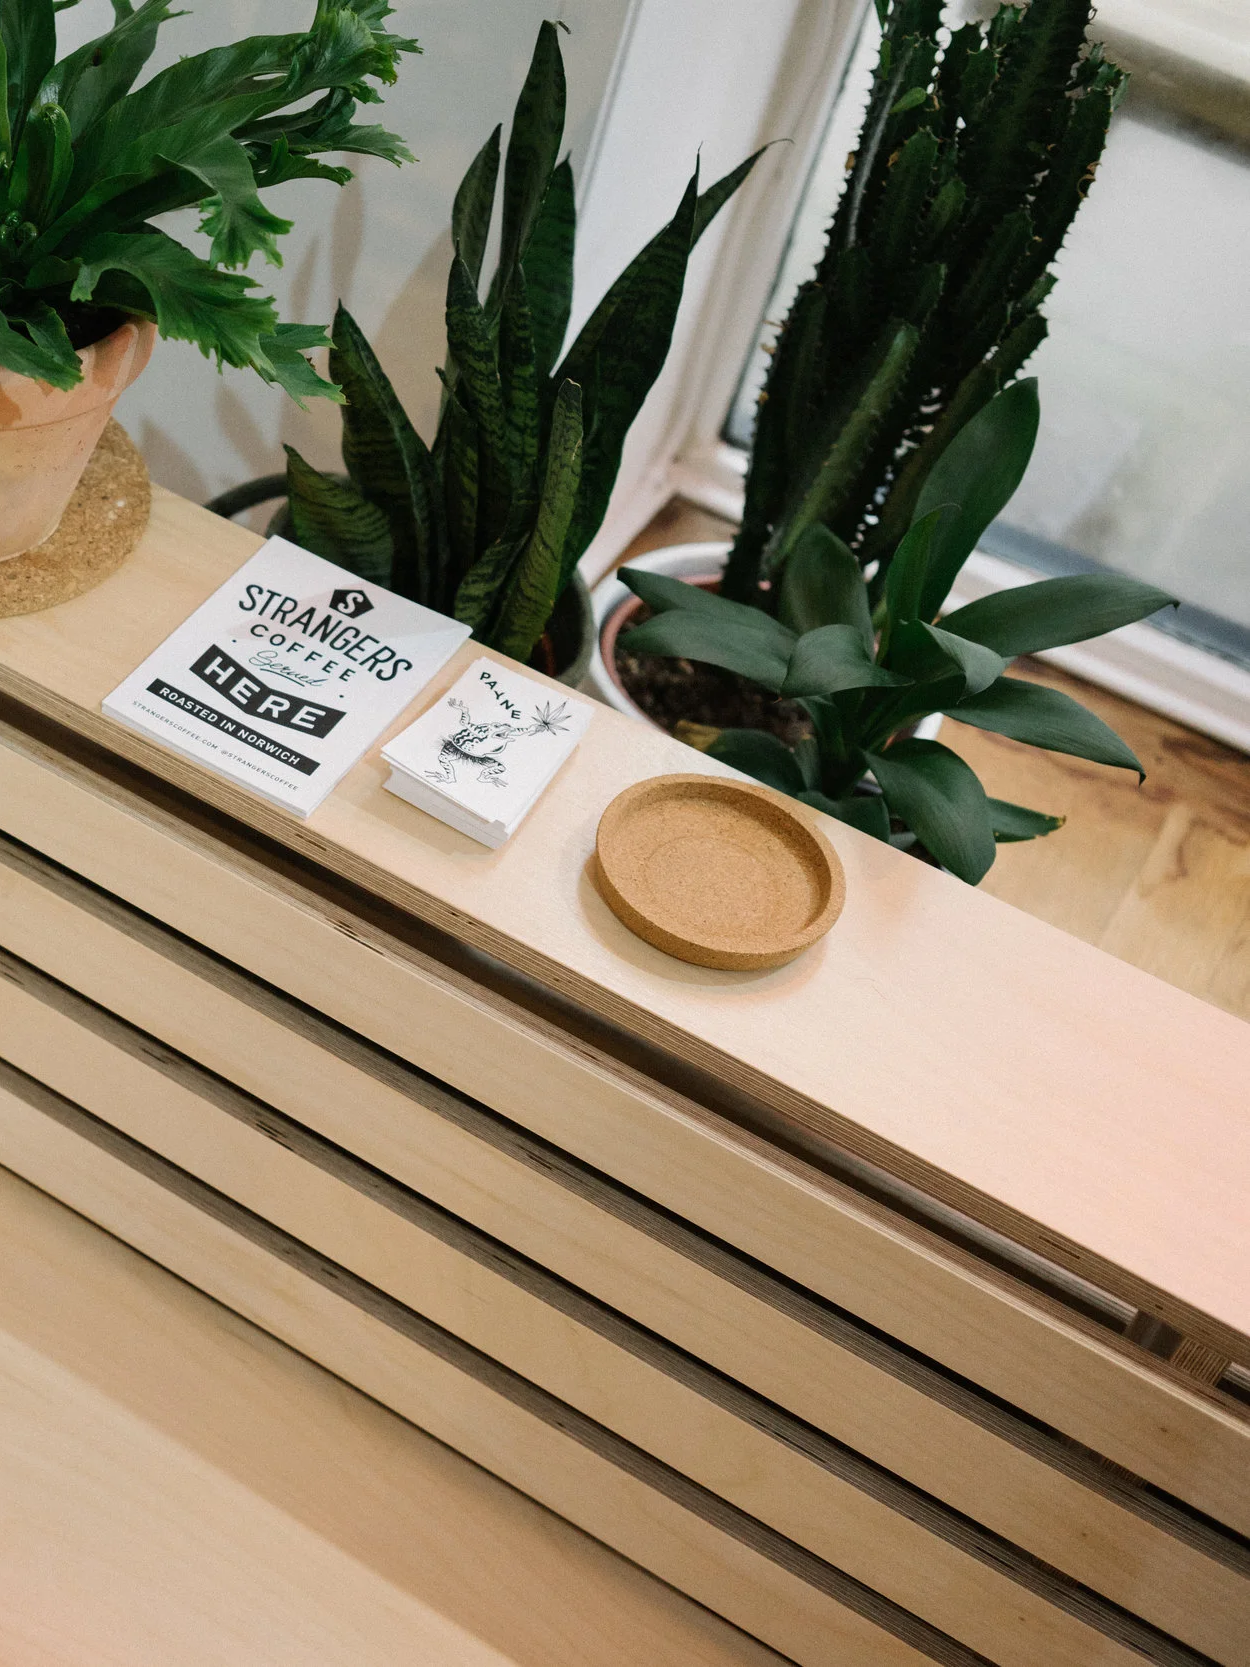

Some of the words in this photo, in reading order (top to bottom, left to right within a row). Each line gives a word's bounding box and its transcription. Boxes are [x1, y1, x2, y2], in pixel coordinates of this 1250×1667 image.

[238, 584, 413, 681] STRANGERS
[337, 591, 364, 615] S
[249, 650, 328, 687] Served
[250, 623, 356, 682] COFFEE
[203, 656, 327, 729] HERE
[480, 672, 521, 720] PAYNE
[132, 700, 219, 750] STRANGERSCOFFEE.COM
[221, 750, 299, 791] @STRANGERSCOFFEE
[159, 687, 217, 722] ROASTED
[220, 719, 235, 733] IN
[237, 728, 300, 765] NORWICH
